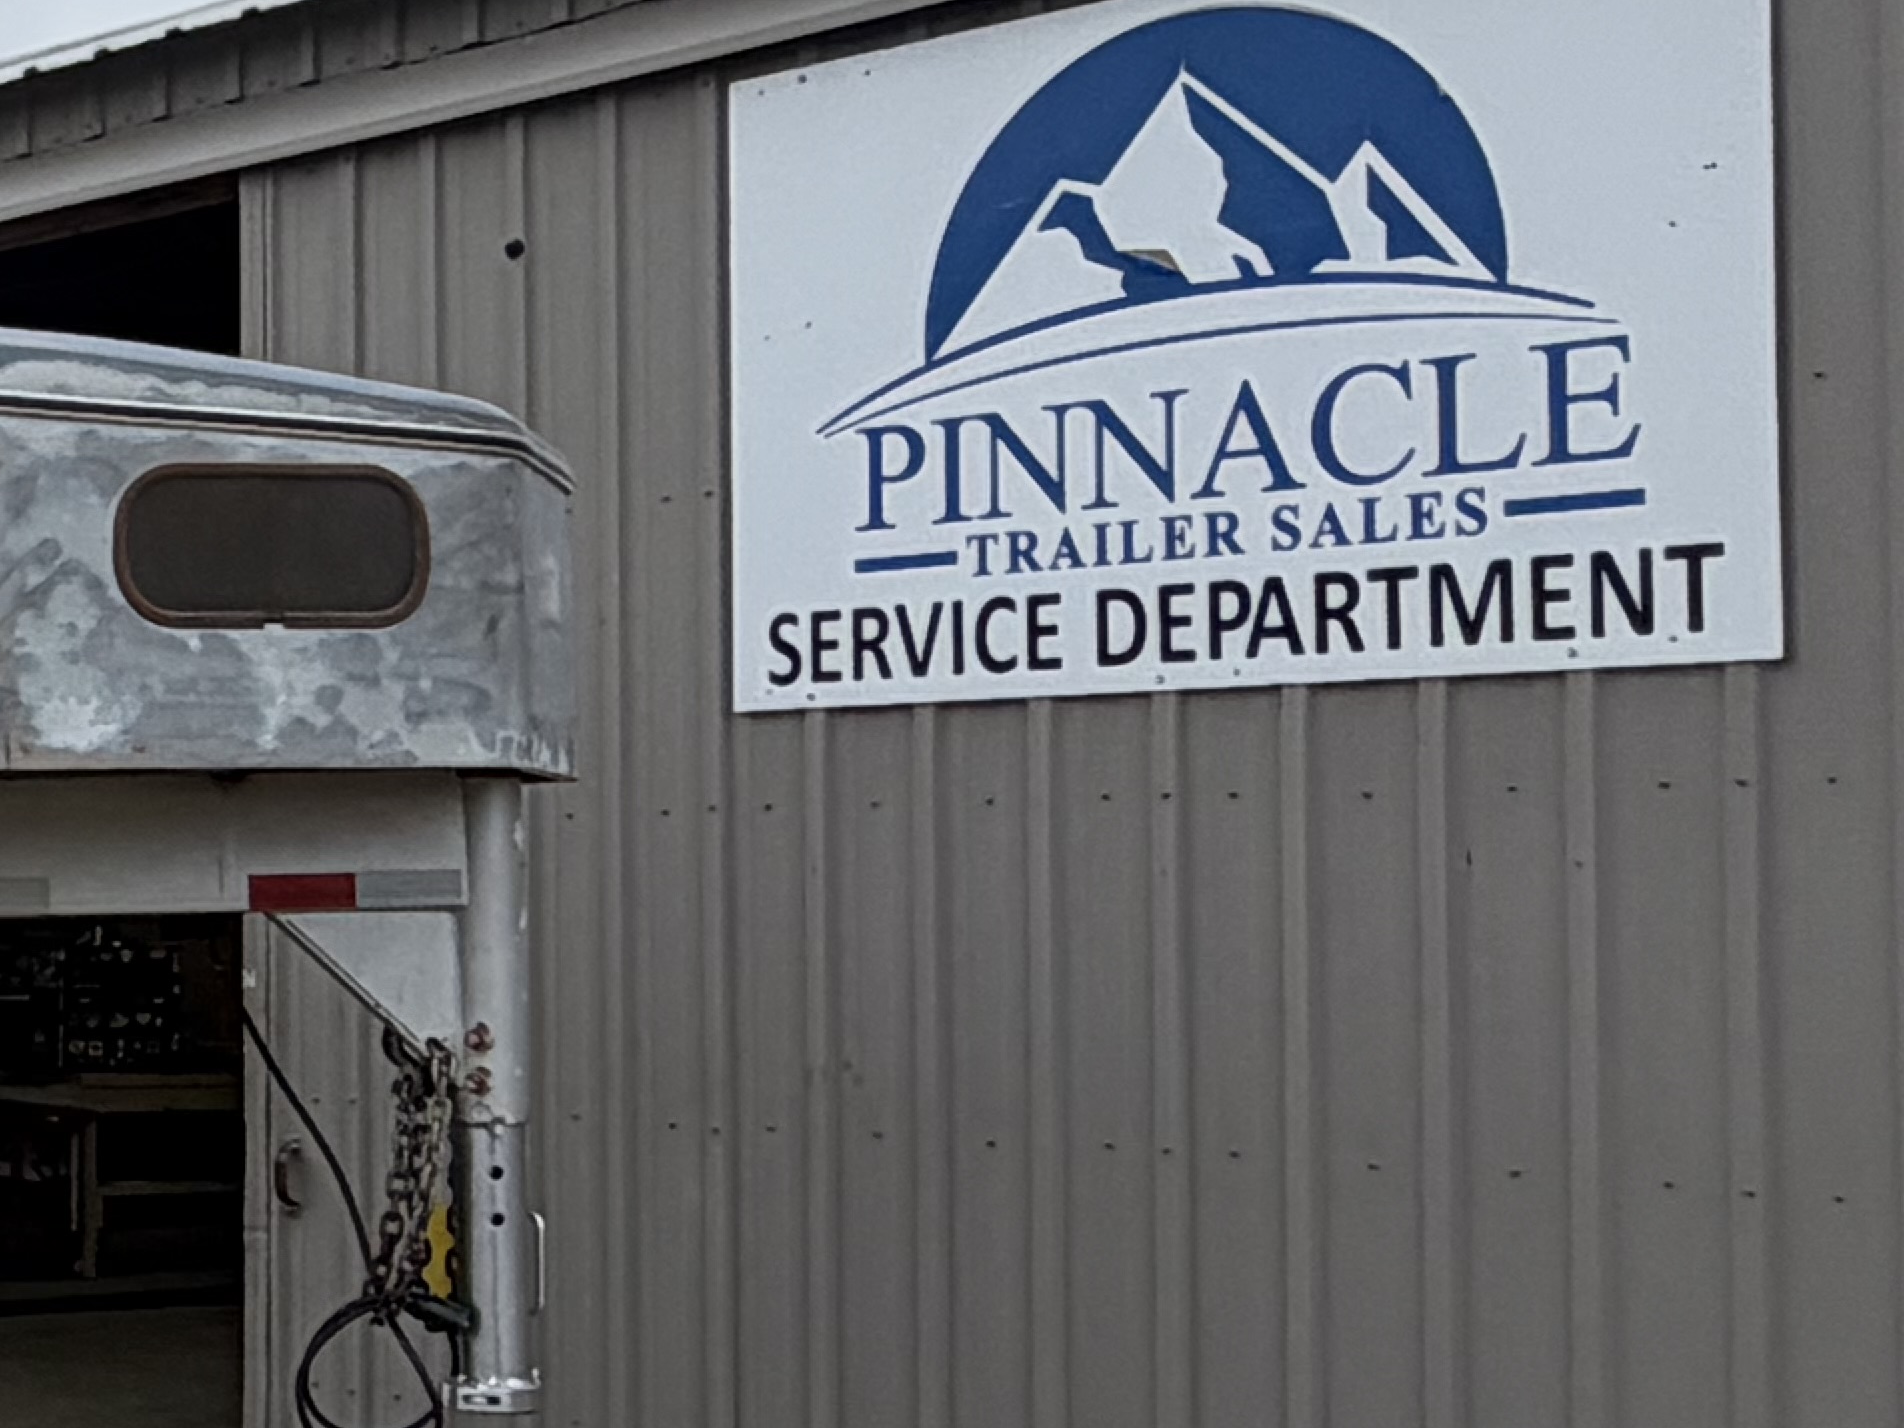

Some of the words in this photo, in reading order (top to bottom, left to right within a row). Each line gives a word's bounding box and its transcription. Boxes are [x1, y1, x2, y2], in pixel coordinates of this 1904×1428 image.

[853, 333, 1643, 533] PINNACLE
[965, 510, 1246, 578] TRAILER
[1271, 486, 1490, 553] SALES
[766, 591, 1064, 688] SERVICE
[1094, 541, 1726, 669] DEPARTMENT
